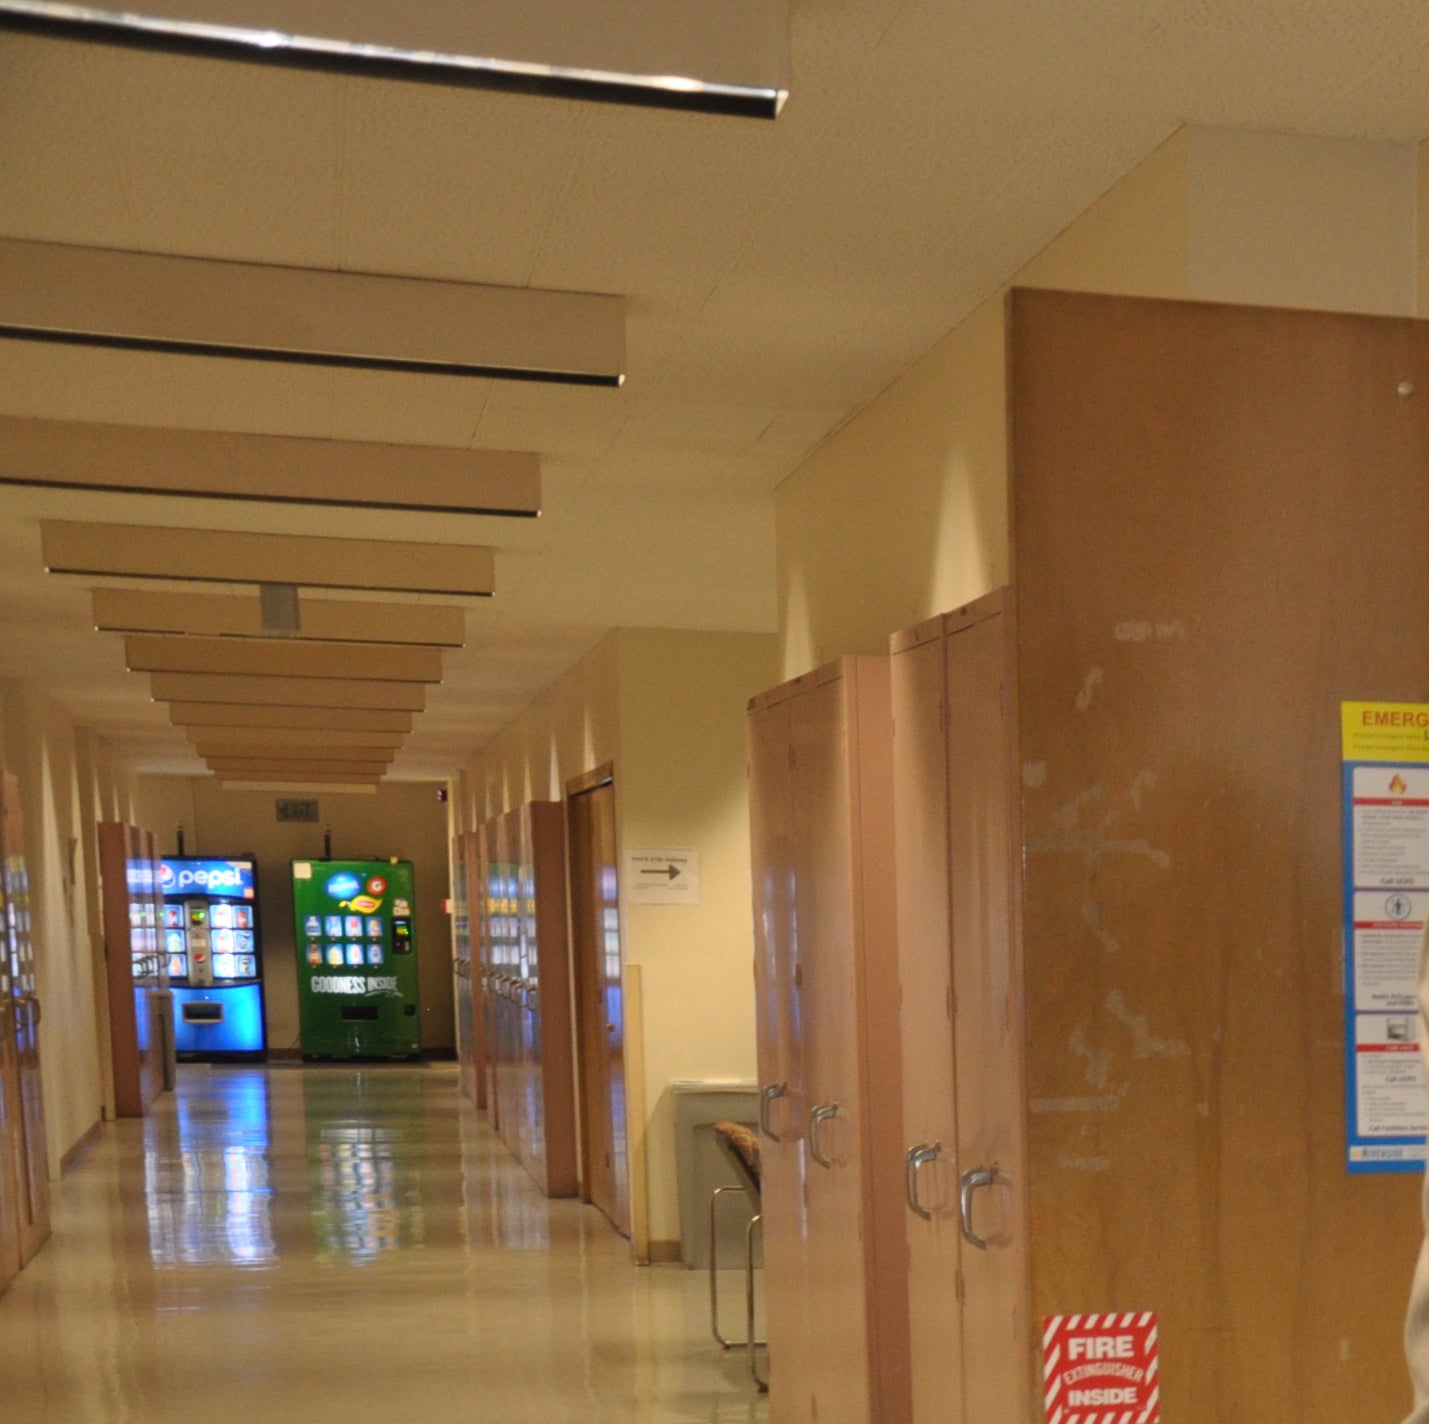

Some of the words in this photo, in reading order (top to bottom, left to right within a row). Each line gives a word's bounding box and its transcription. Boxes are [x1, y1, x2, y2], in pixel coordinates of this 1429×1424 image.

[178, 866, 244, 889] pepsi
[371, 880, 383, 892] G
[311, 976, 366, 994] GOODNESS
[367, 976, 397, 991] INSIDE
[1068, 1335, 1135, 1360] FIRE
[1062, 1362, 1144, 1385] EXTINGUISHER
[1068, 1387, 1138, 1407] INSIDE
